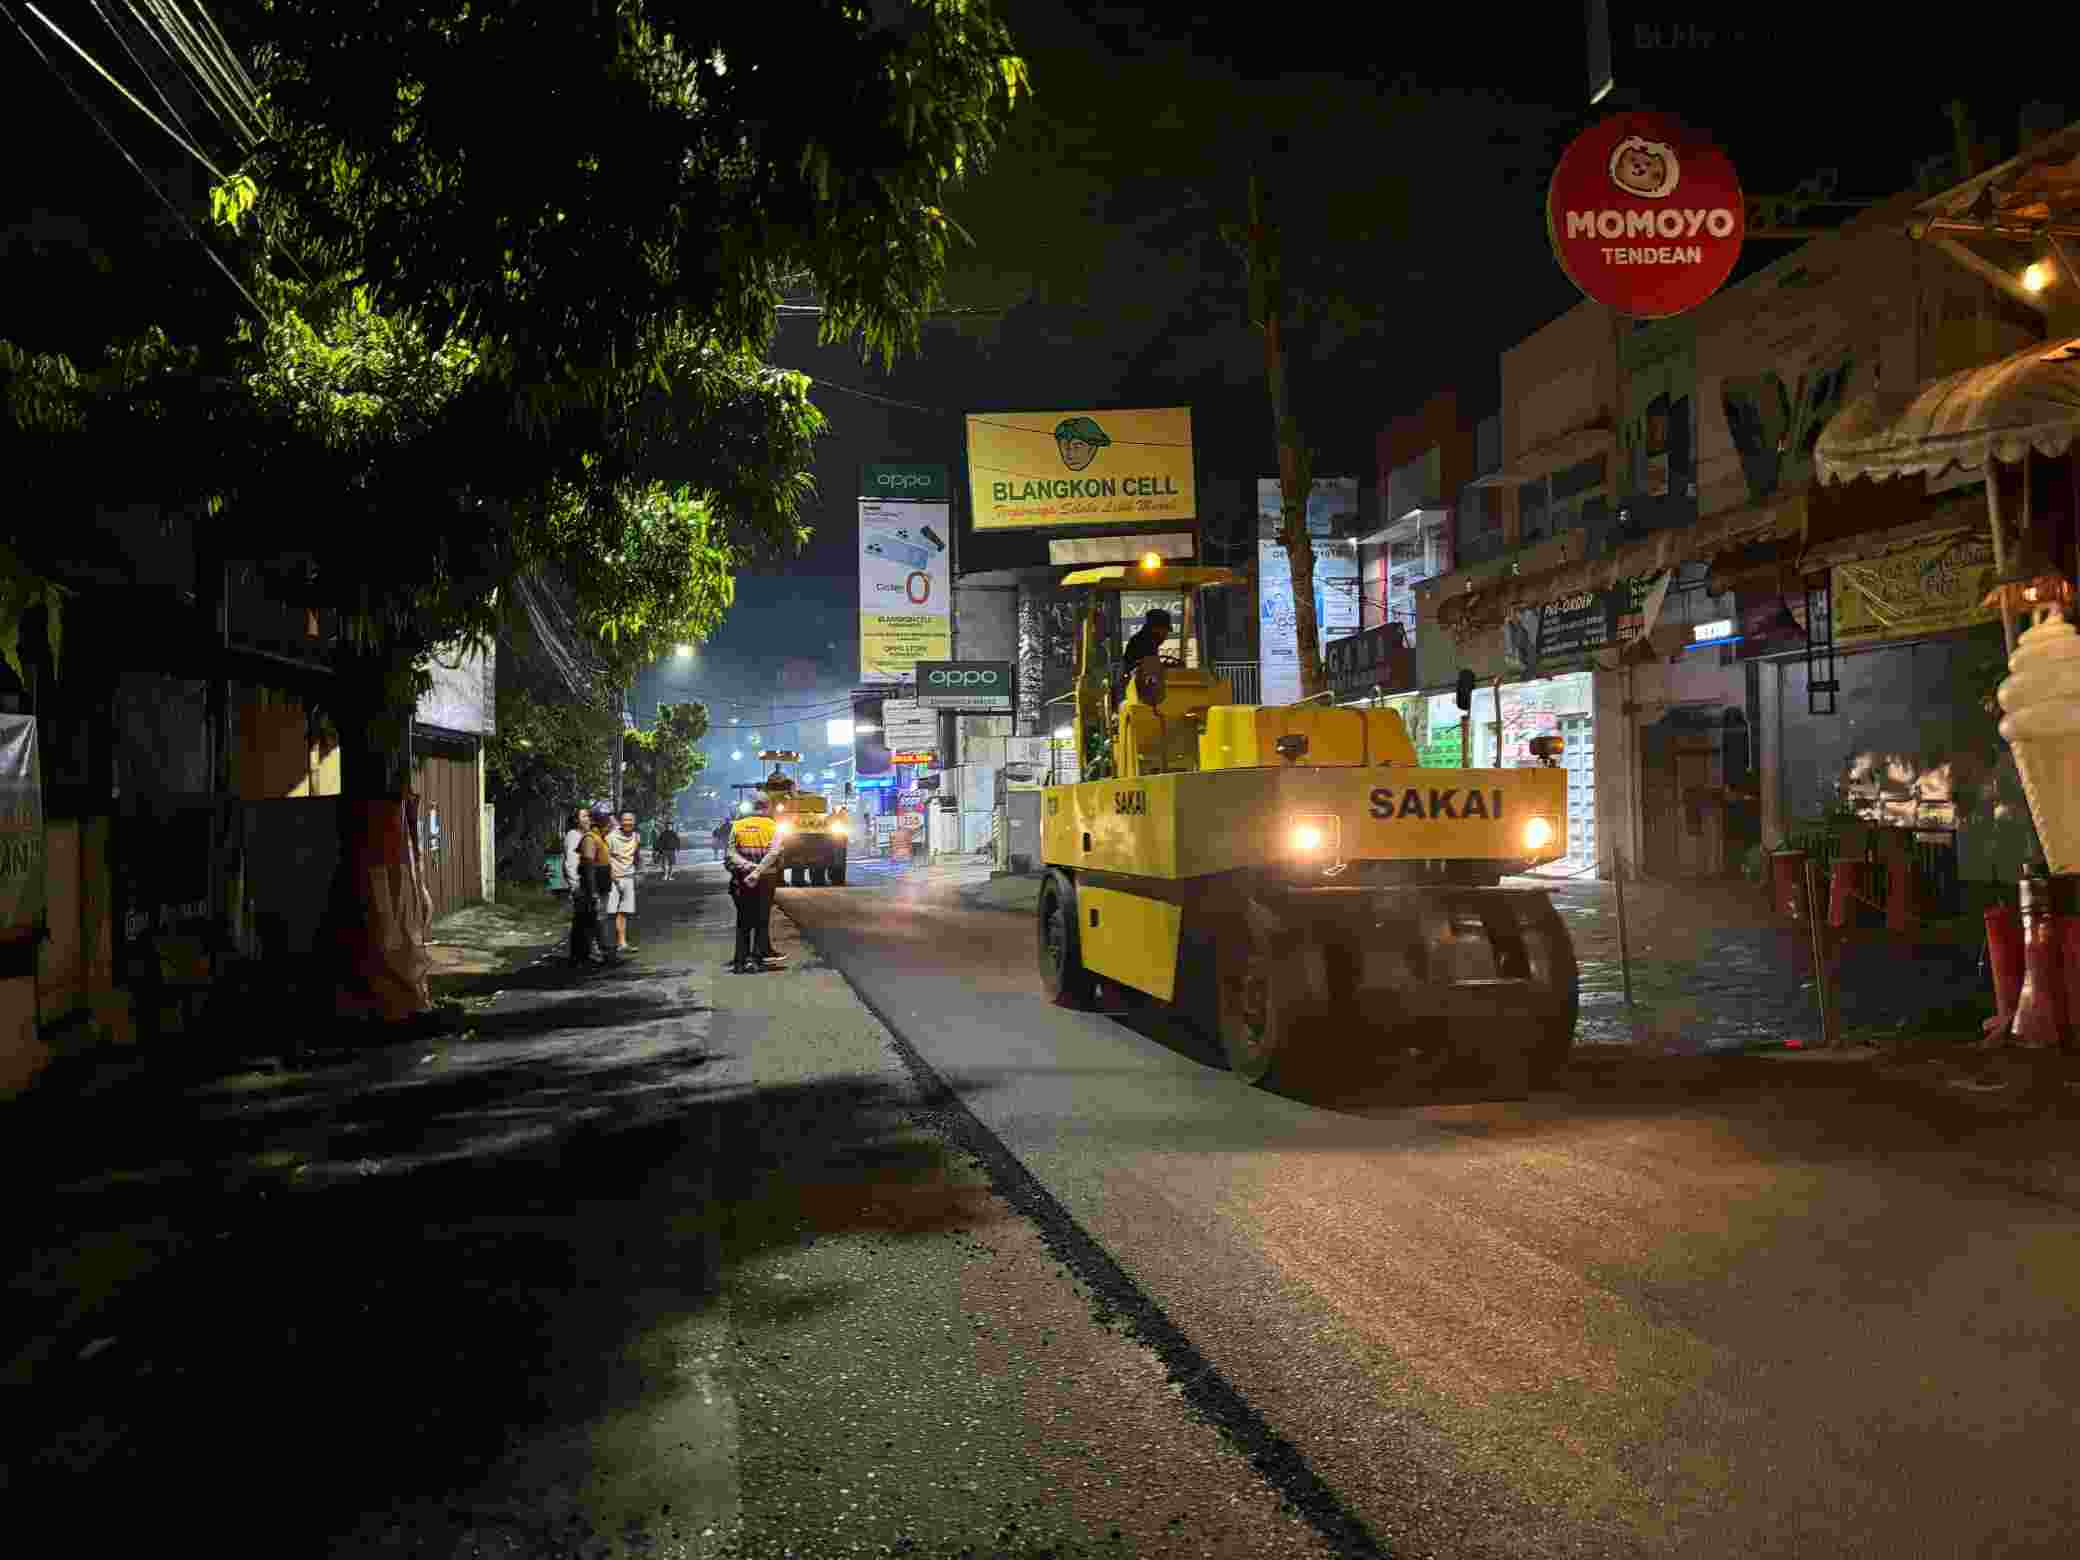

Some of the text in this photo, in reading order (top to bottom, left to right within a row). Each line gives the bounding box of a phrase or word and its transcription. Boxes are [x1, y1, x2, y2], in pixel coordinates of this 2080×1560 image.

[1565, 208, 1735, 240] MOMOYO
[1600, 246, 1702, 266] TENDEAN
[877, 474, 930, 490] oppo
[992, 475, 1178, 502] BLANGKON CELL
[928, 671, 998, 687] oppo
[1369, 787, 1503, 820] SAKAI
